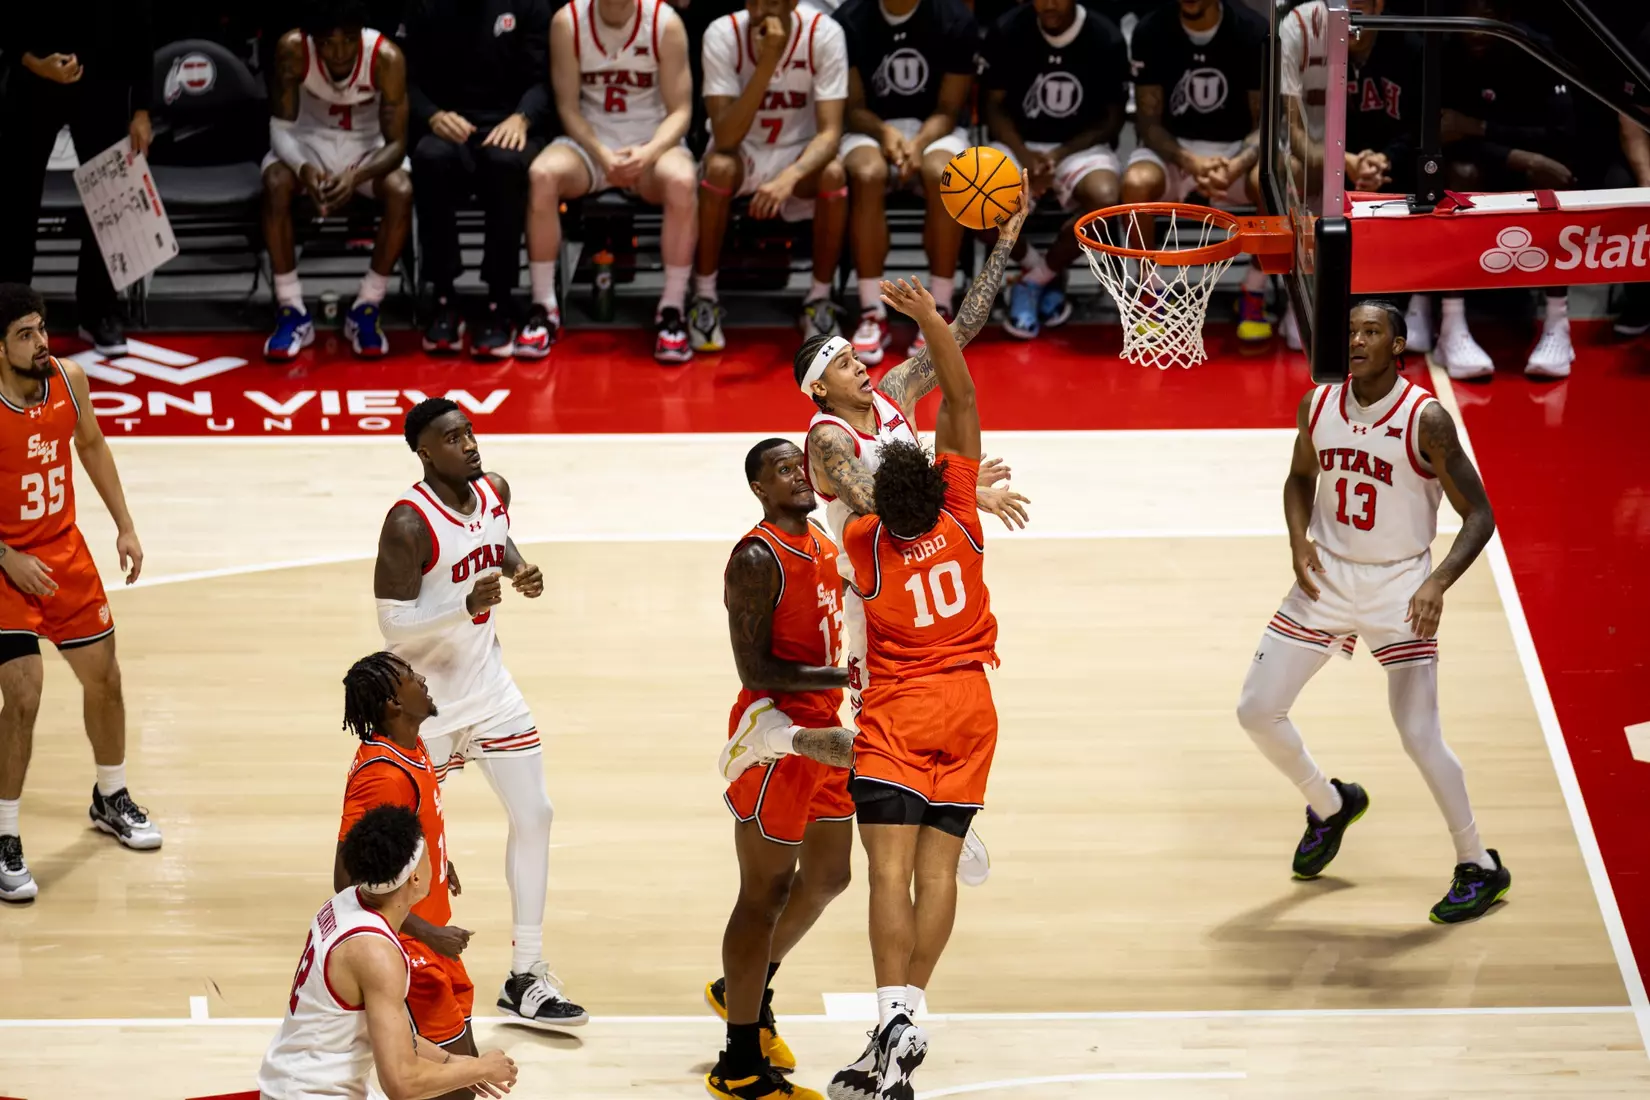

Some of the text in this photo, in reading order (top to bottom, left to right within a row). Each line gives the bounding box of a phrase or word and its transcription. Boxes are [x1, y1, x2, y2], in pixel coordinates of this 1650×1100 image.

[892, 57, 921, 88] U
[604, 86, 627, 113] 6
[1045, 80, 1075, 112] U
[1192, 75, 1220, 106] U
[760, 118, 783, 144] 7
[1554, 223, 1650, 271] Stat
[243, 388, 511, 416] VIEW
[206, 416, 392, 432] UNIO
[1318, 447, 1394, 487] UTAH
[20, 465, 66, 521] 35
[1335, 477, 1378, 532] 13
[901, 533, 948, 566] FORD
[904, 559, 967, 628] 10
